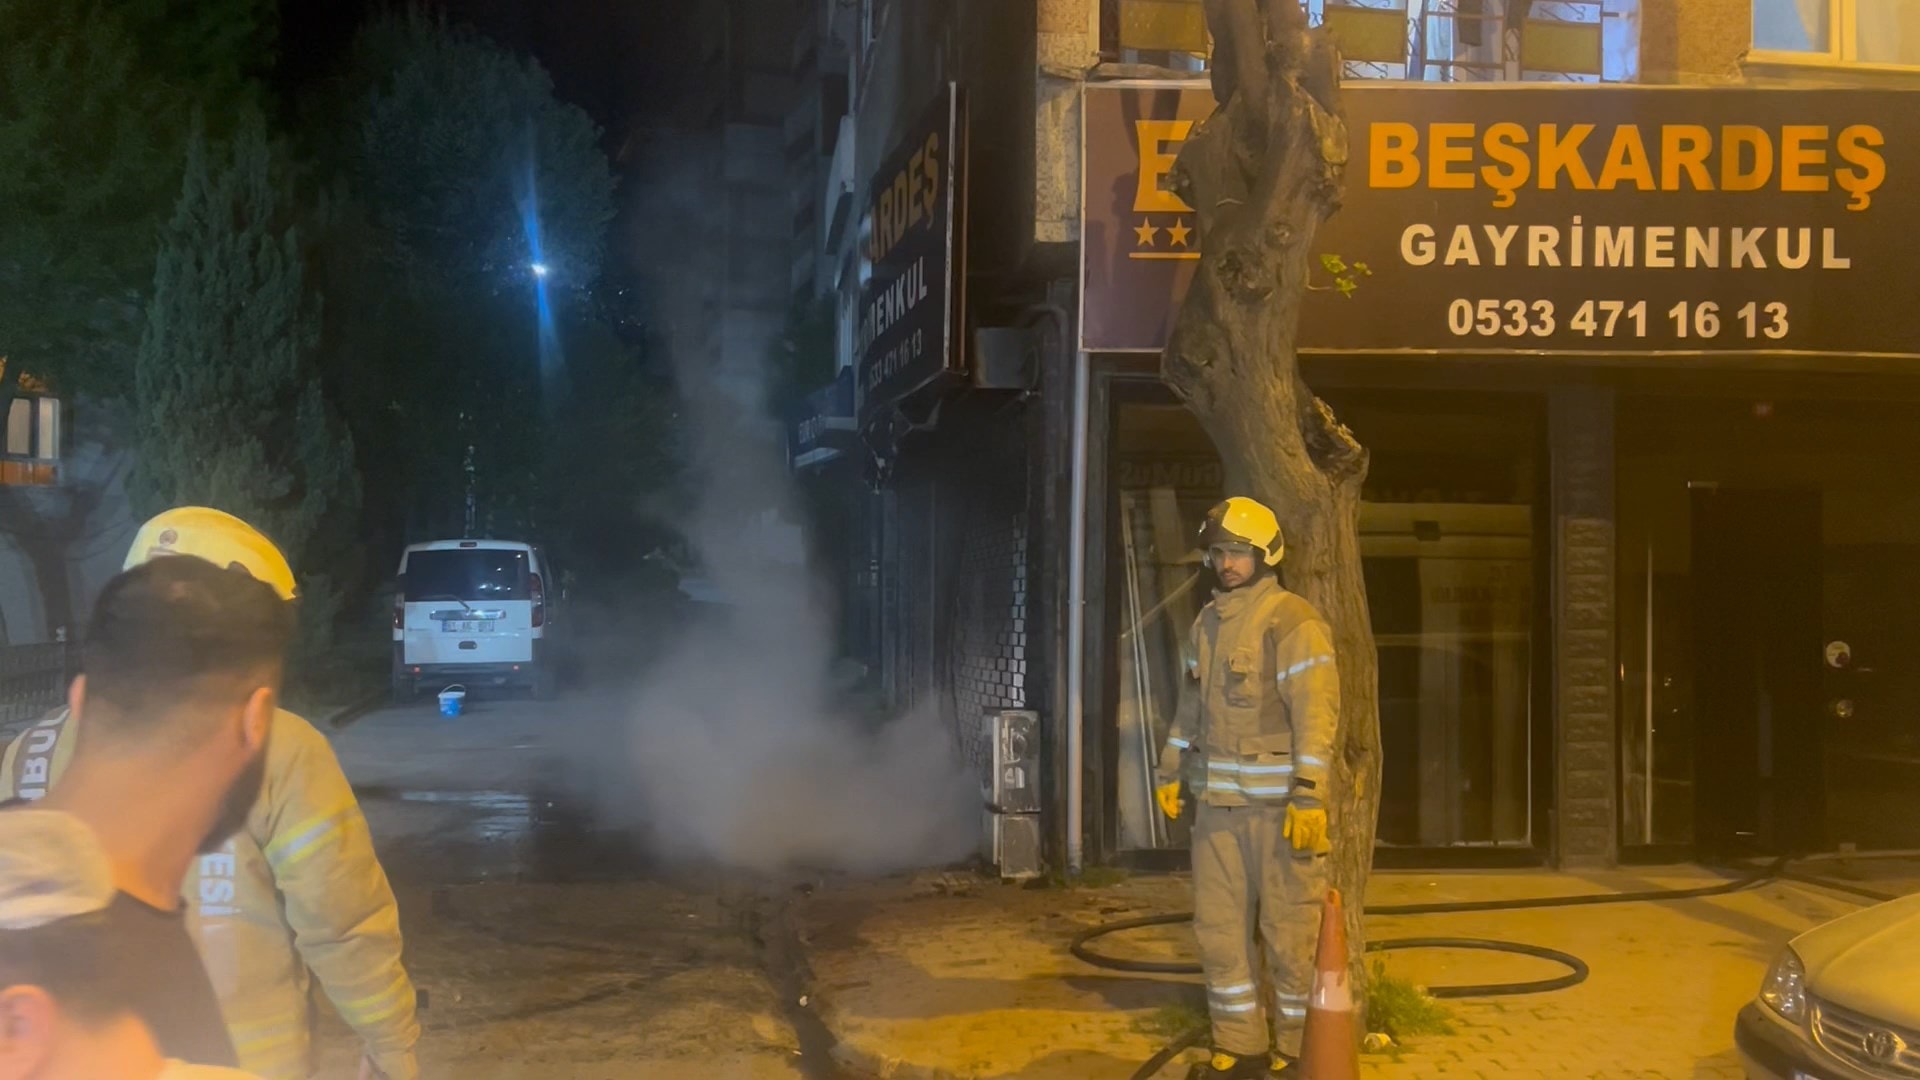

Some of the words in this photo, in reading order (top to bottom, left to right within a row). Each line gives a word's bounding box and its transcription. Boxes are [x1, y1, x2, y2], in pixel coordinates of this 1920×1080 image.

[1369, 122, 1886, 211] BEŞKARDEŞ
[1400, 215, 1850, 269] GAYRİMENKUL
[1448, 298, 1555, 337] 0533
[1570, 300, 1647, 337] 471
[1668, 301, 1720, 338] 16
[1737, 302, 1789, 339] 13
